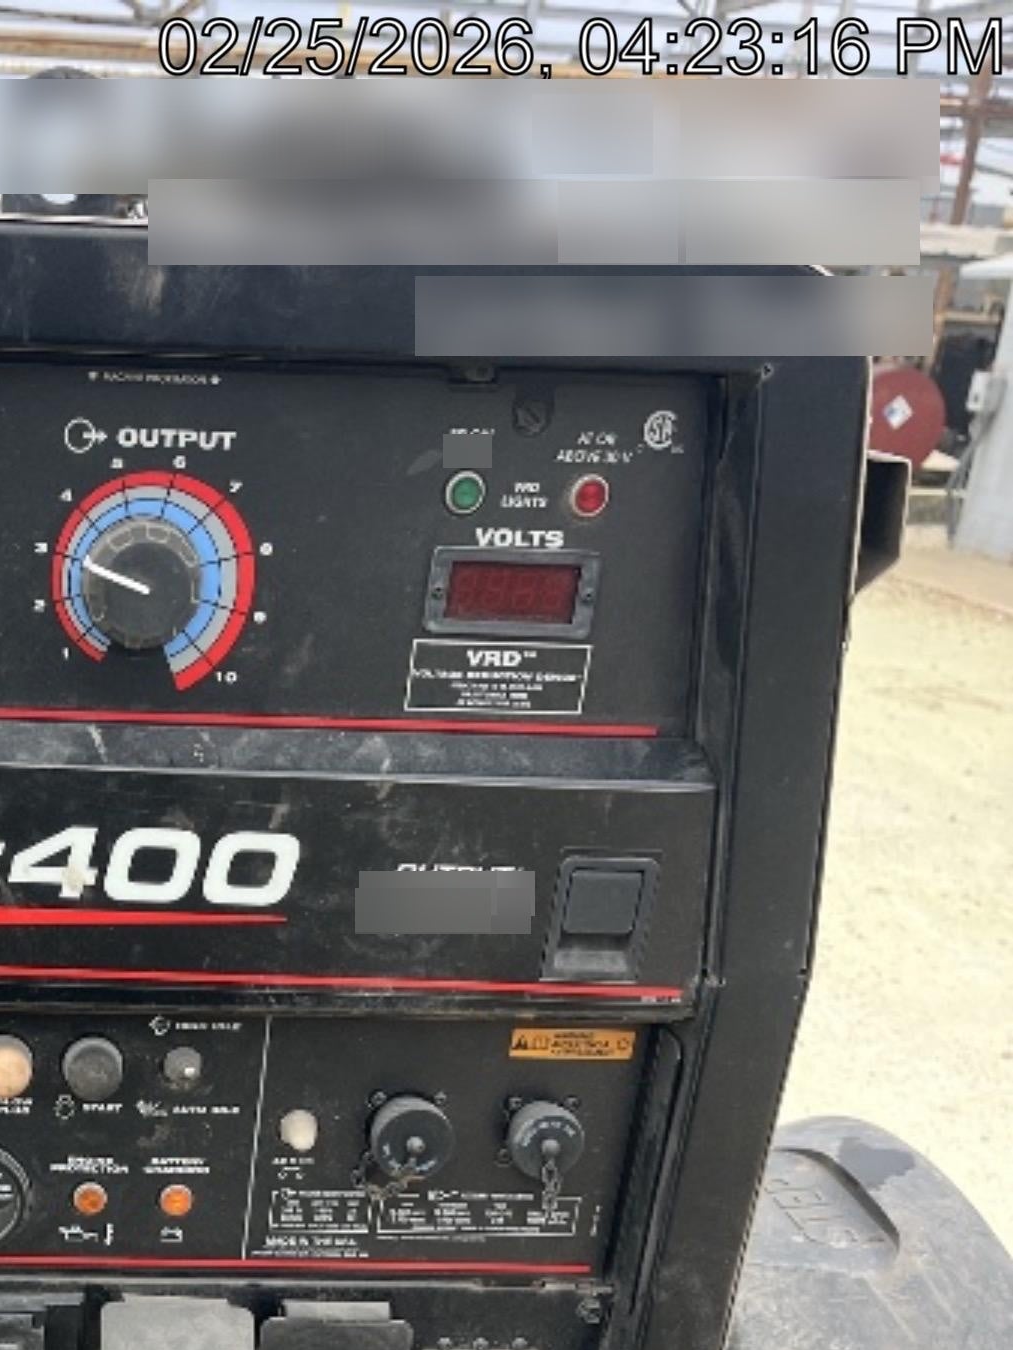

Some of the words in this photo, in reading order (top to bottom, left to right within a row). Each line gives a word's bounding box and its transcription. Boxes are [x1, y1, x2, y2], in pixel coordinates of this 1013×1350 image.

[117, 428, 237, 451] OUTPUT
[174, 455, 186, 469] 6
[60, 488, 73, 501] 4
[475, 528, 565, 549] VOLTS
[62, 647, 70, 660] 1
[216, 671, 238, 684] 10
